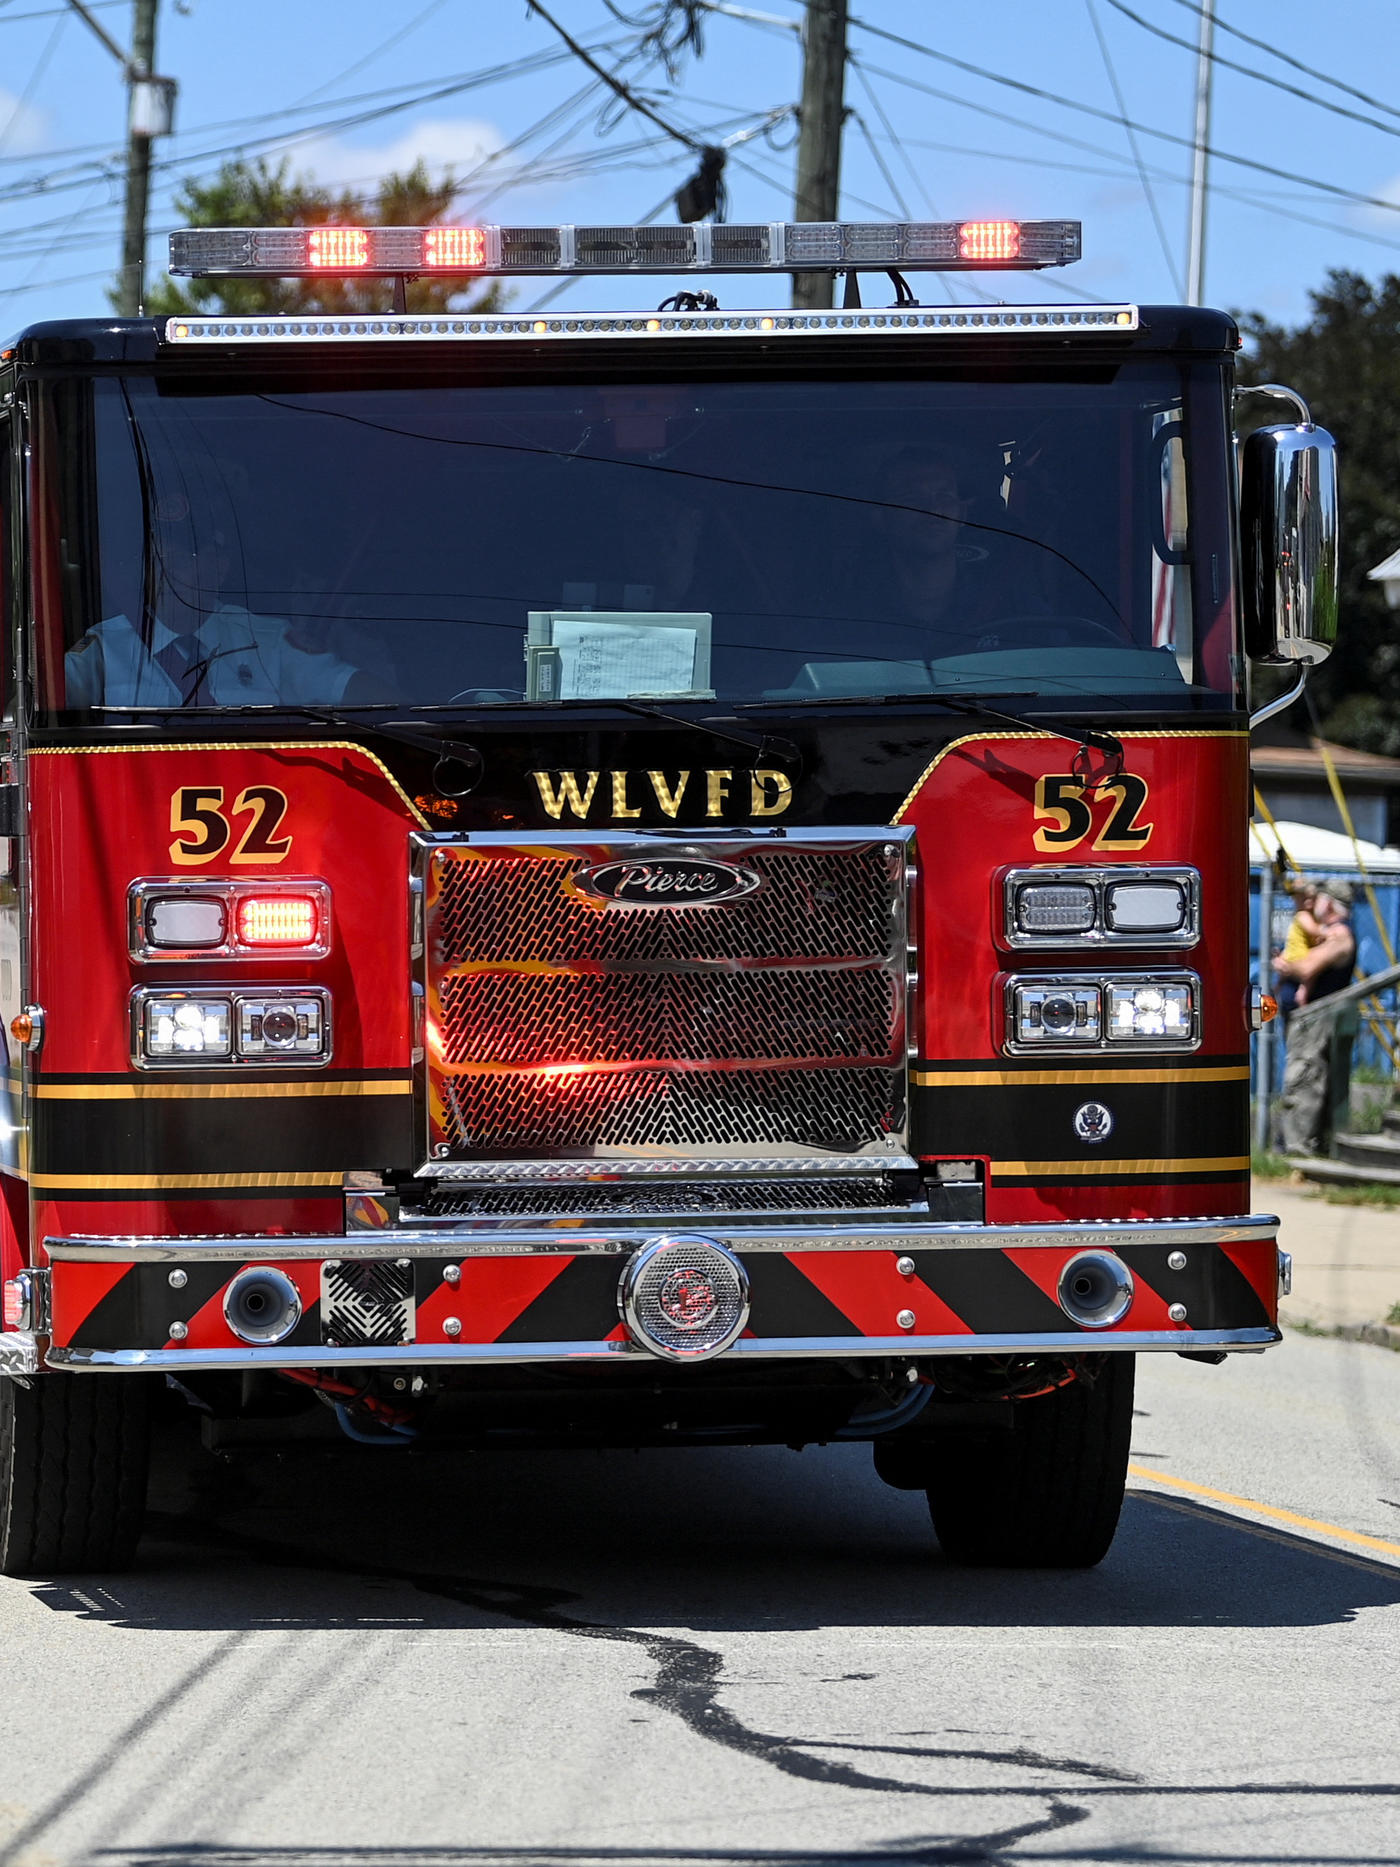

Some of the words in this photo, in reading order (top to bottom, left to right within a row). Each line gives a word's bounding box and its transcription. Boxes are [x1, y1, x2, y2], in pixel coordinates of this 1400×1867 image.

[169, 785, 293, 865] 52
[532, 769, 793, 820] WLVFD
[1032, 773, 1154, 852] 52
[613, 865, 720, 898] Pierce
